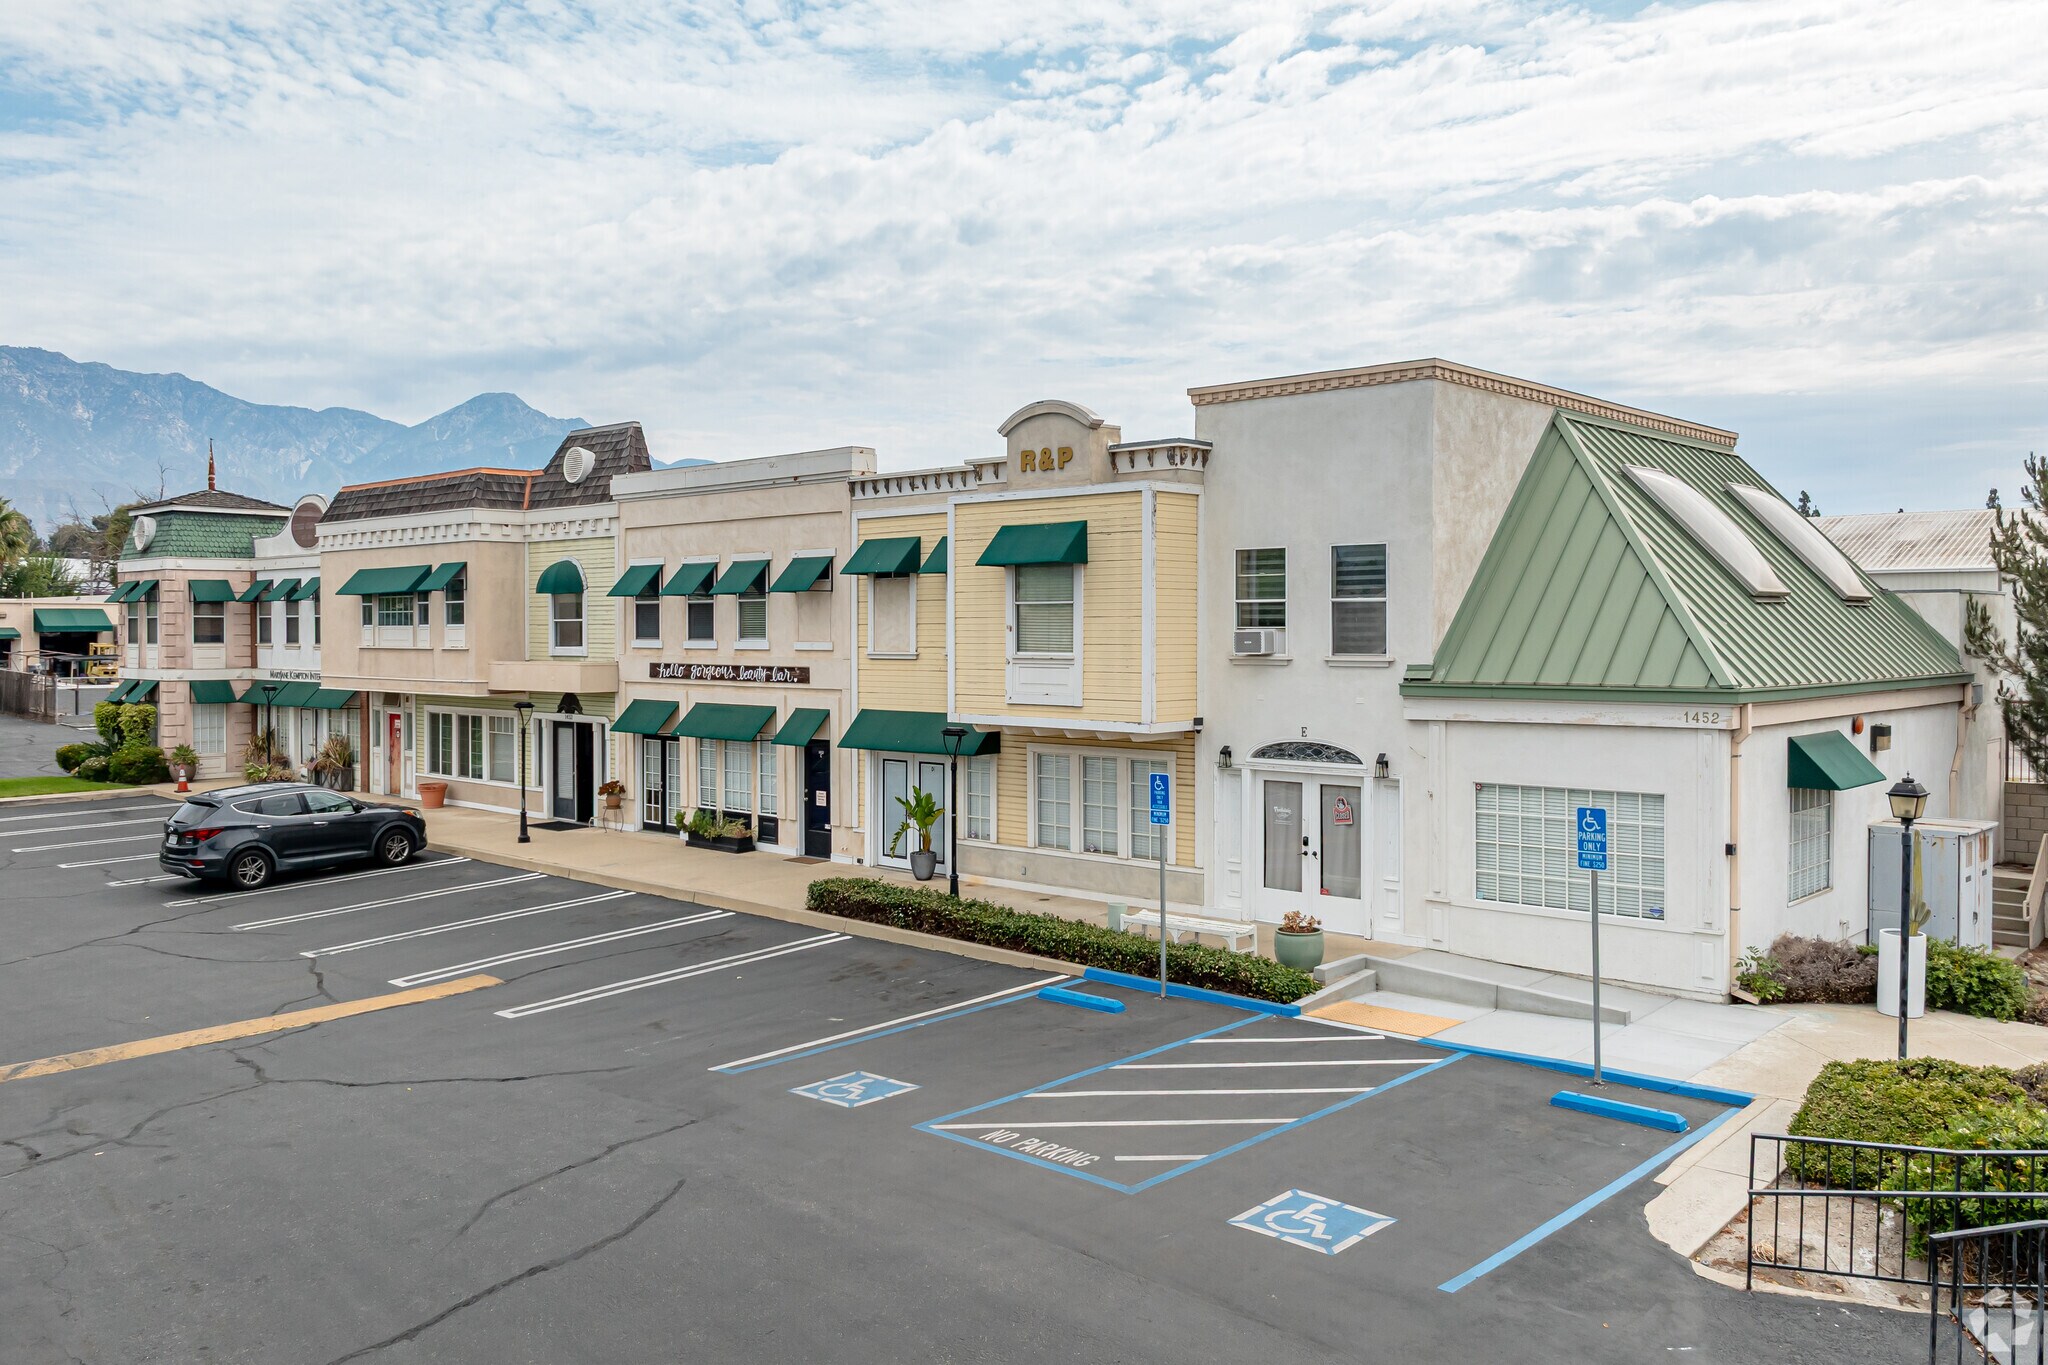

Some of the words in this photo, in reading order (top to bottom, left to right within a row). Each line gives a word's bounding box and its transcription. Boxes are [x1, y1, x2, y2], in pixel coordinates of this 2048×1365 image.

[1021, 446, 1073, 472] R&P
[657, 663, 686, 678] hello
[691, 664, 736, 680] gorgeous
[1684, 711, 1719, 724] 1452
[1301, 726, 1308, 737] E
[1578, 831, 1606, 842] PARKING
[1583, 841, 1601, 851] ONLY
[1582, 853, 1603, 861] MINIMUM
[1579, 859, 1591, 867] FINE
[1592, 860, 1605, 868] $250
[979, 1129, 1020, 1143] NO
[1010, 1137, 1100, 1167] PARKING
